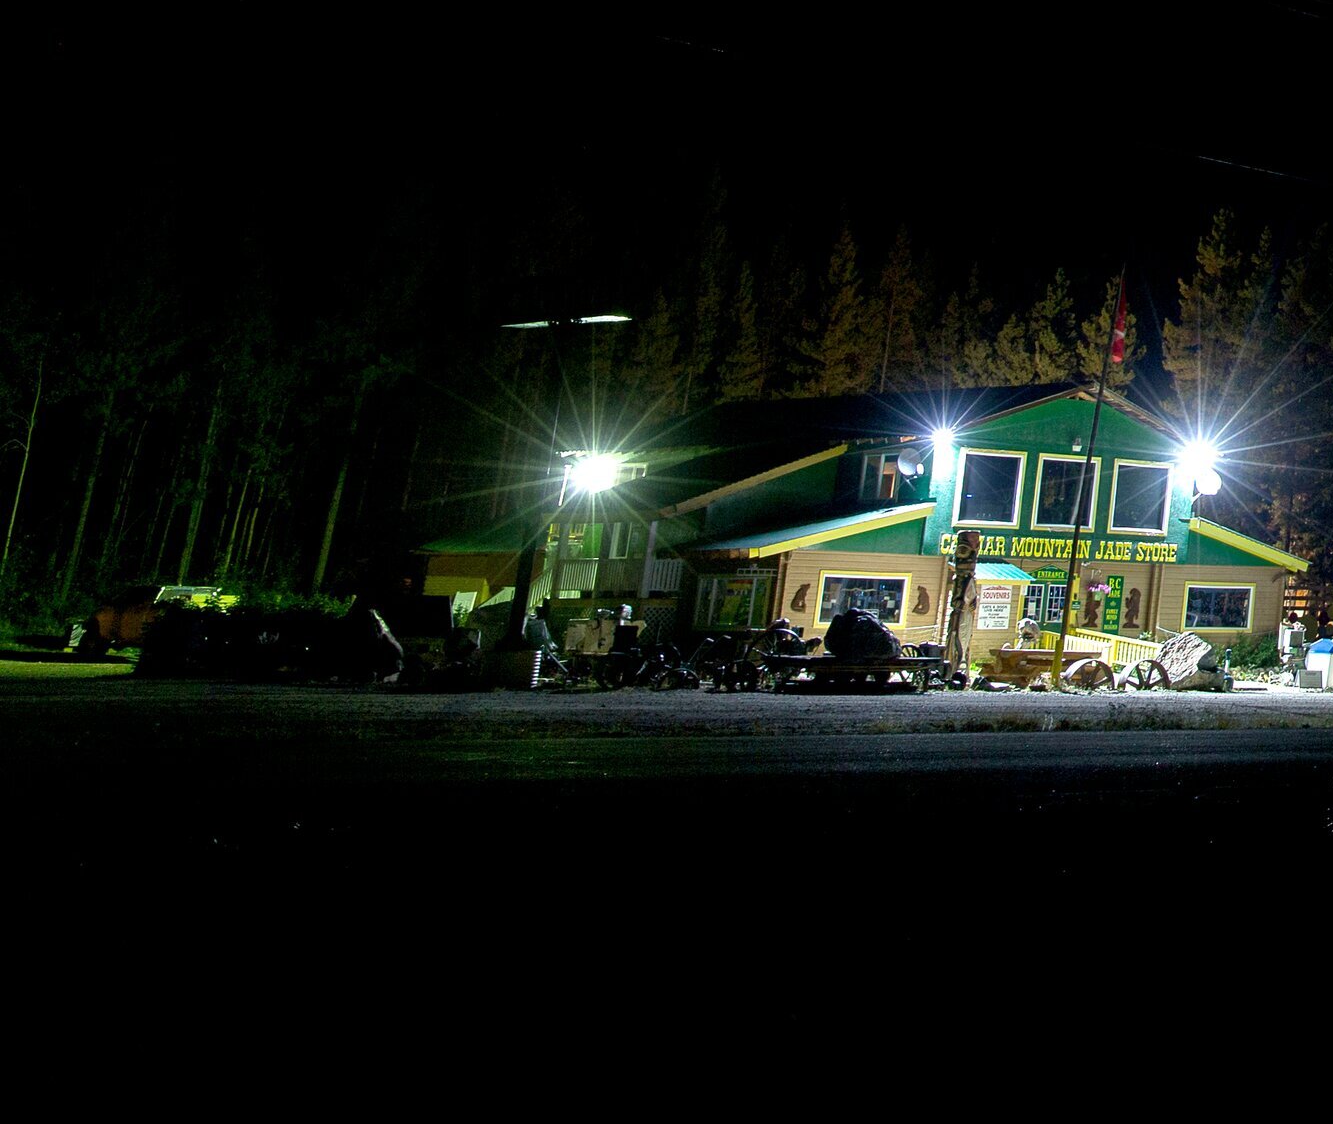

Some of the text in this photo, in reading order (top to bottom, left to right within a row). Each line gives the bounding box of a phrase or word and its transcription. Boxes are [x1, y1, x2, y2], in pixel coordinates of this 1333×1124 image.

[1095, 540, 1132, 561] JADE
[1136, 542, 1178, 562] STORE
[1037, 570, 1065, 579] ENTRANCE
[982, 591, 1010, 599] SOUVENIRS
